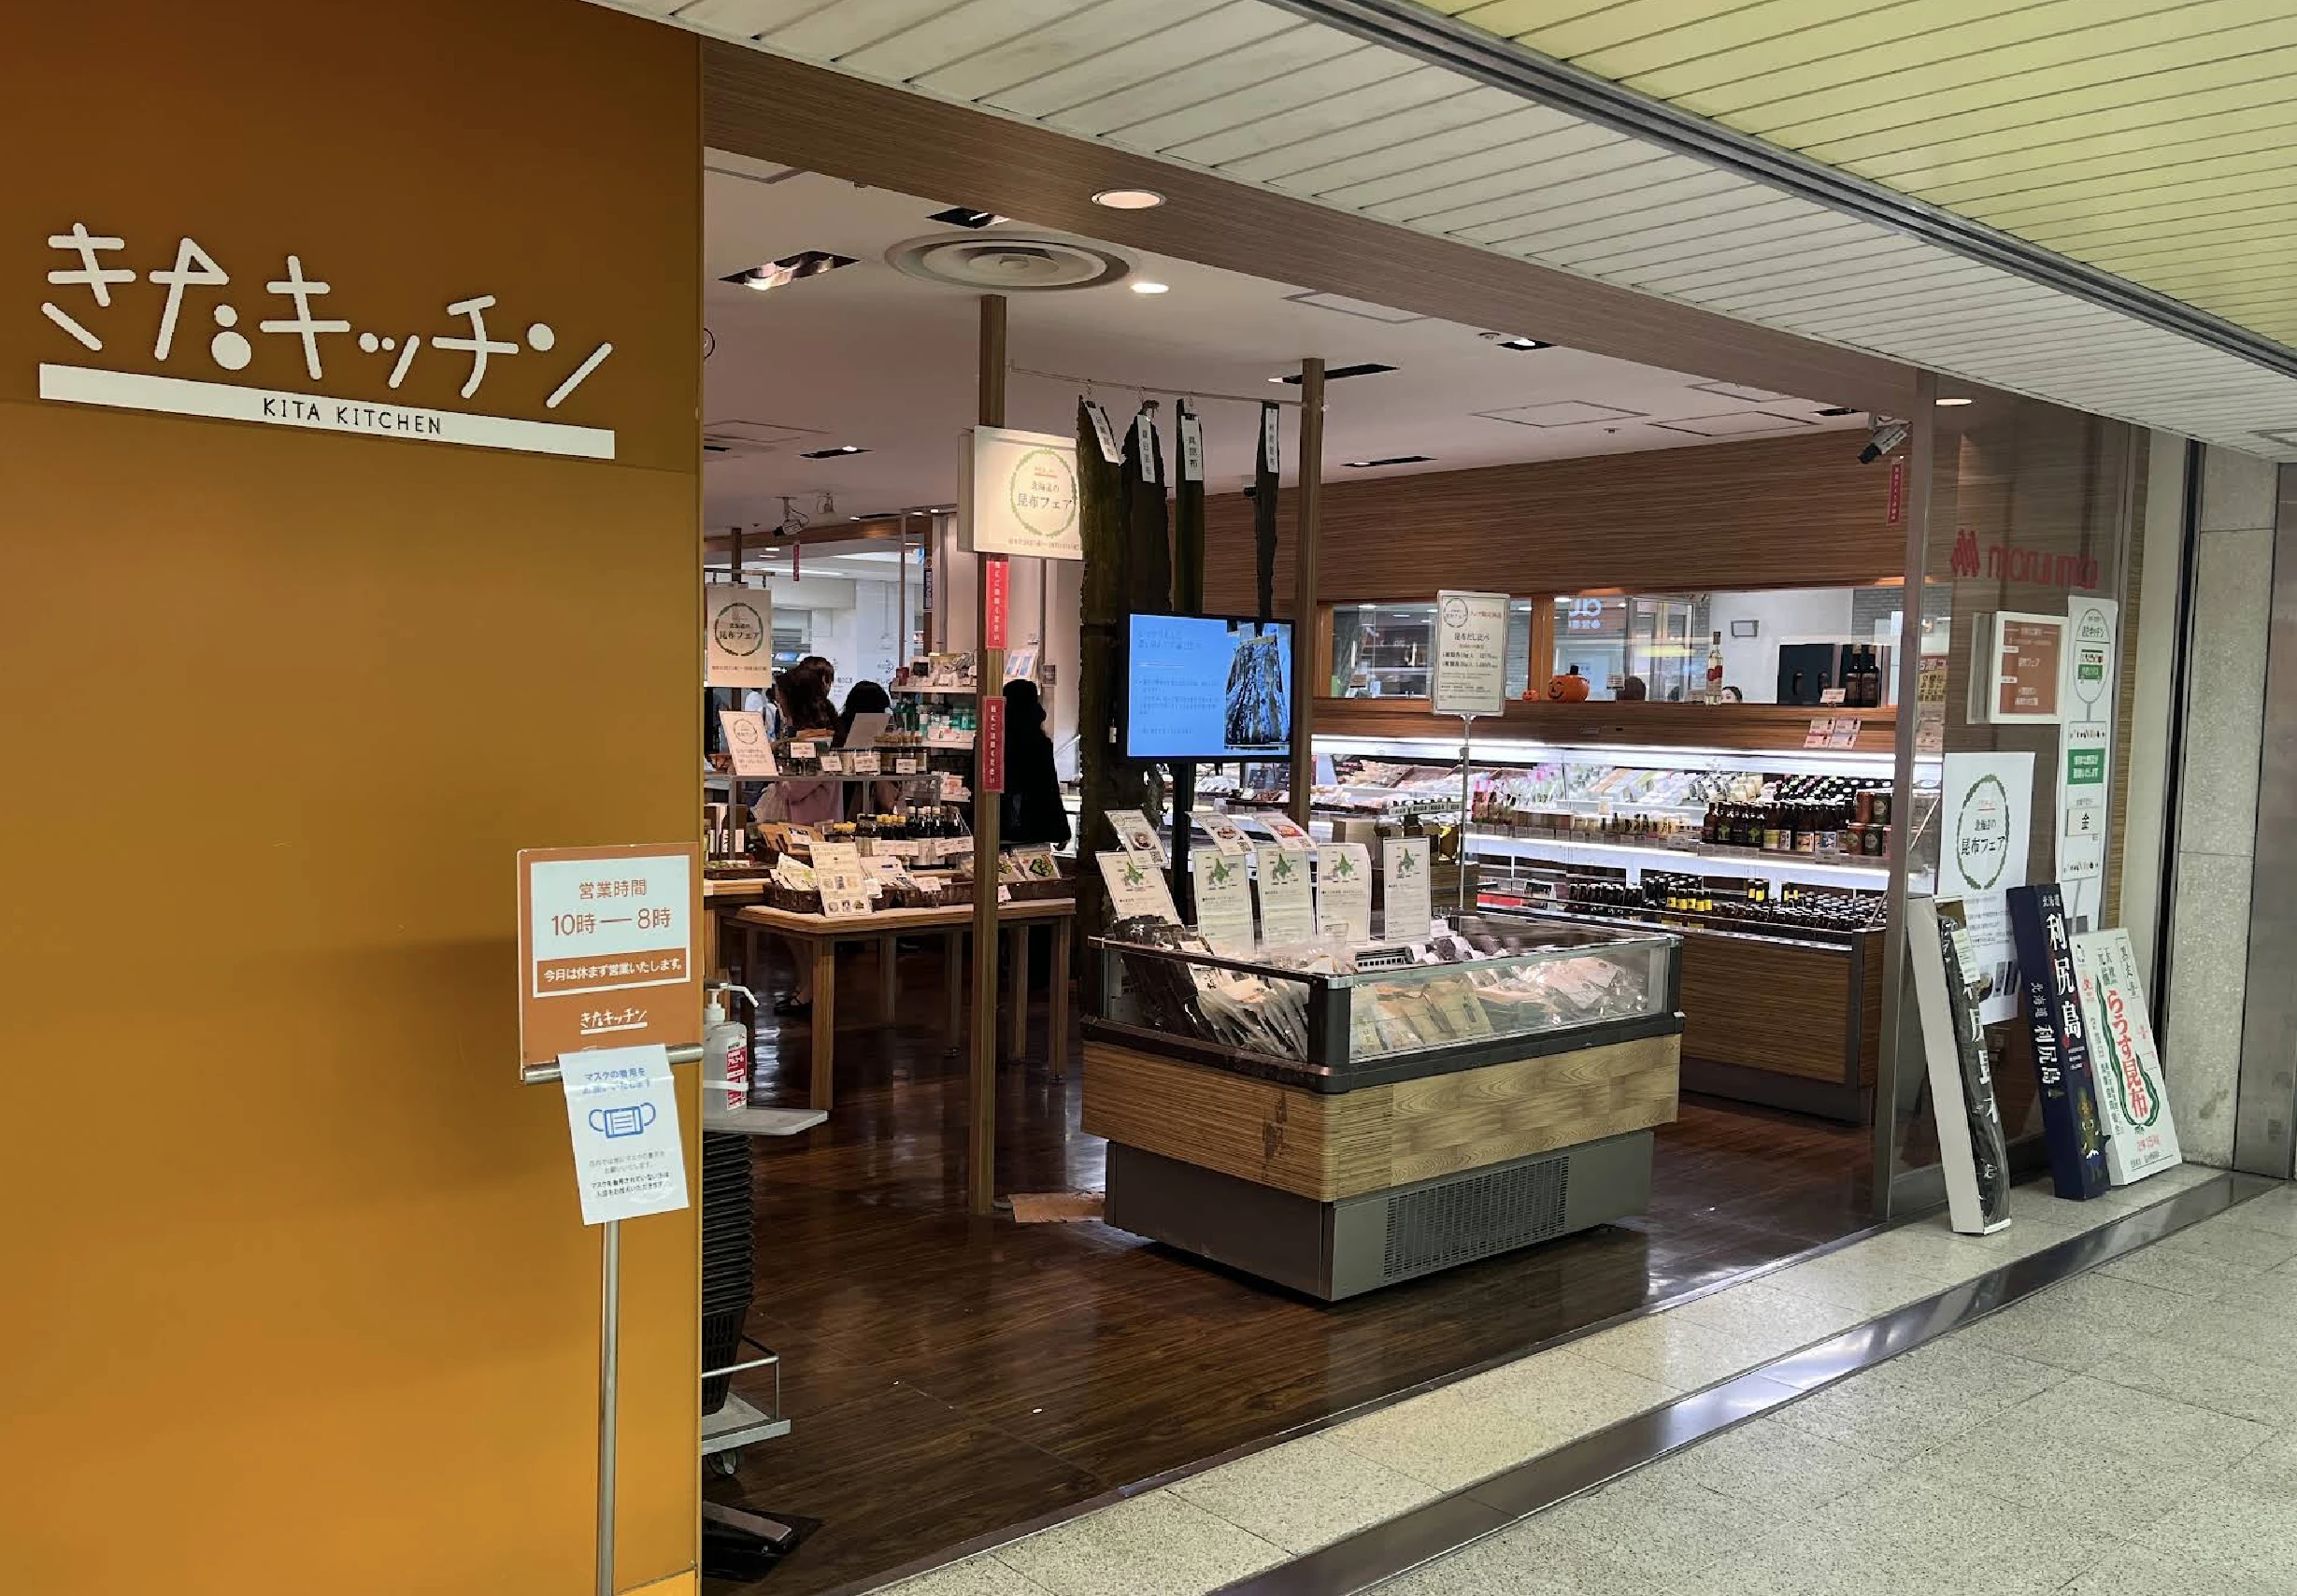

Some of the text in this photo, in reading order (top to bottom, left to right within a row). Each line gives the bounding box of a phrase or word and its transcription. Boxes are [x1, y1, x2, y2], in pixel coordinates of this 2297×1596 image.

[41, 221, 613, 408] きたキッチン
[262, 397, 443, 435] KITA KITCHEN
[1017, 492, 1073, 510] 昆布フェア
[1962, 835, 2006, 857] 昆布フェア
[578, 877, 648, 900] 営業時間
[580, 1007, 648, 1029] きたキッチン
